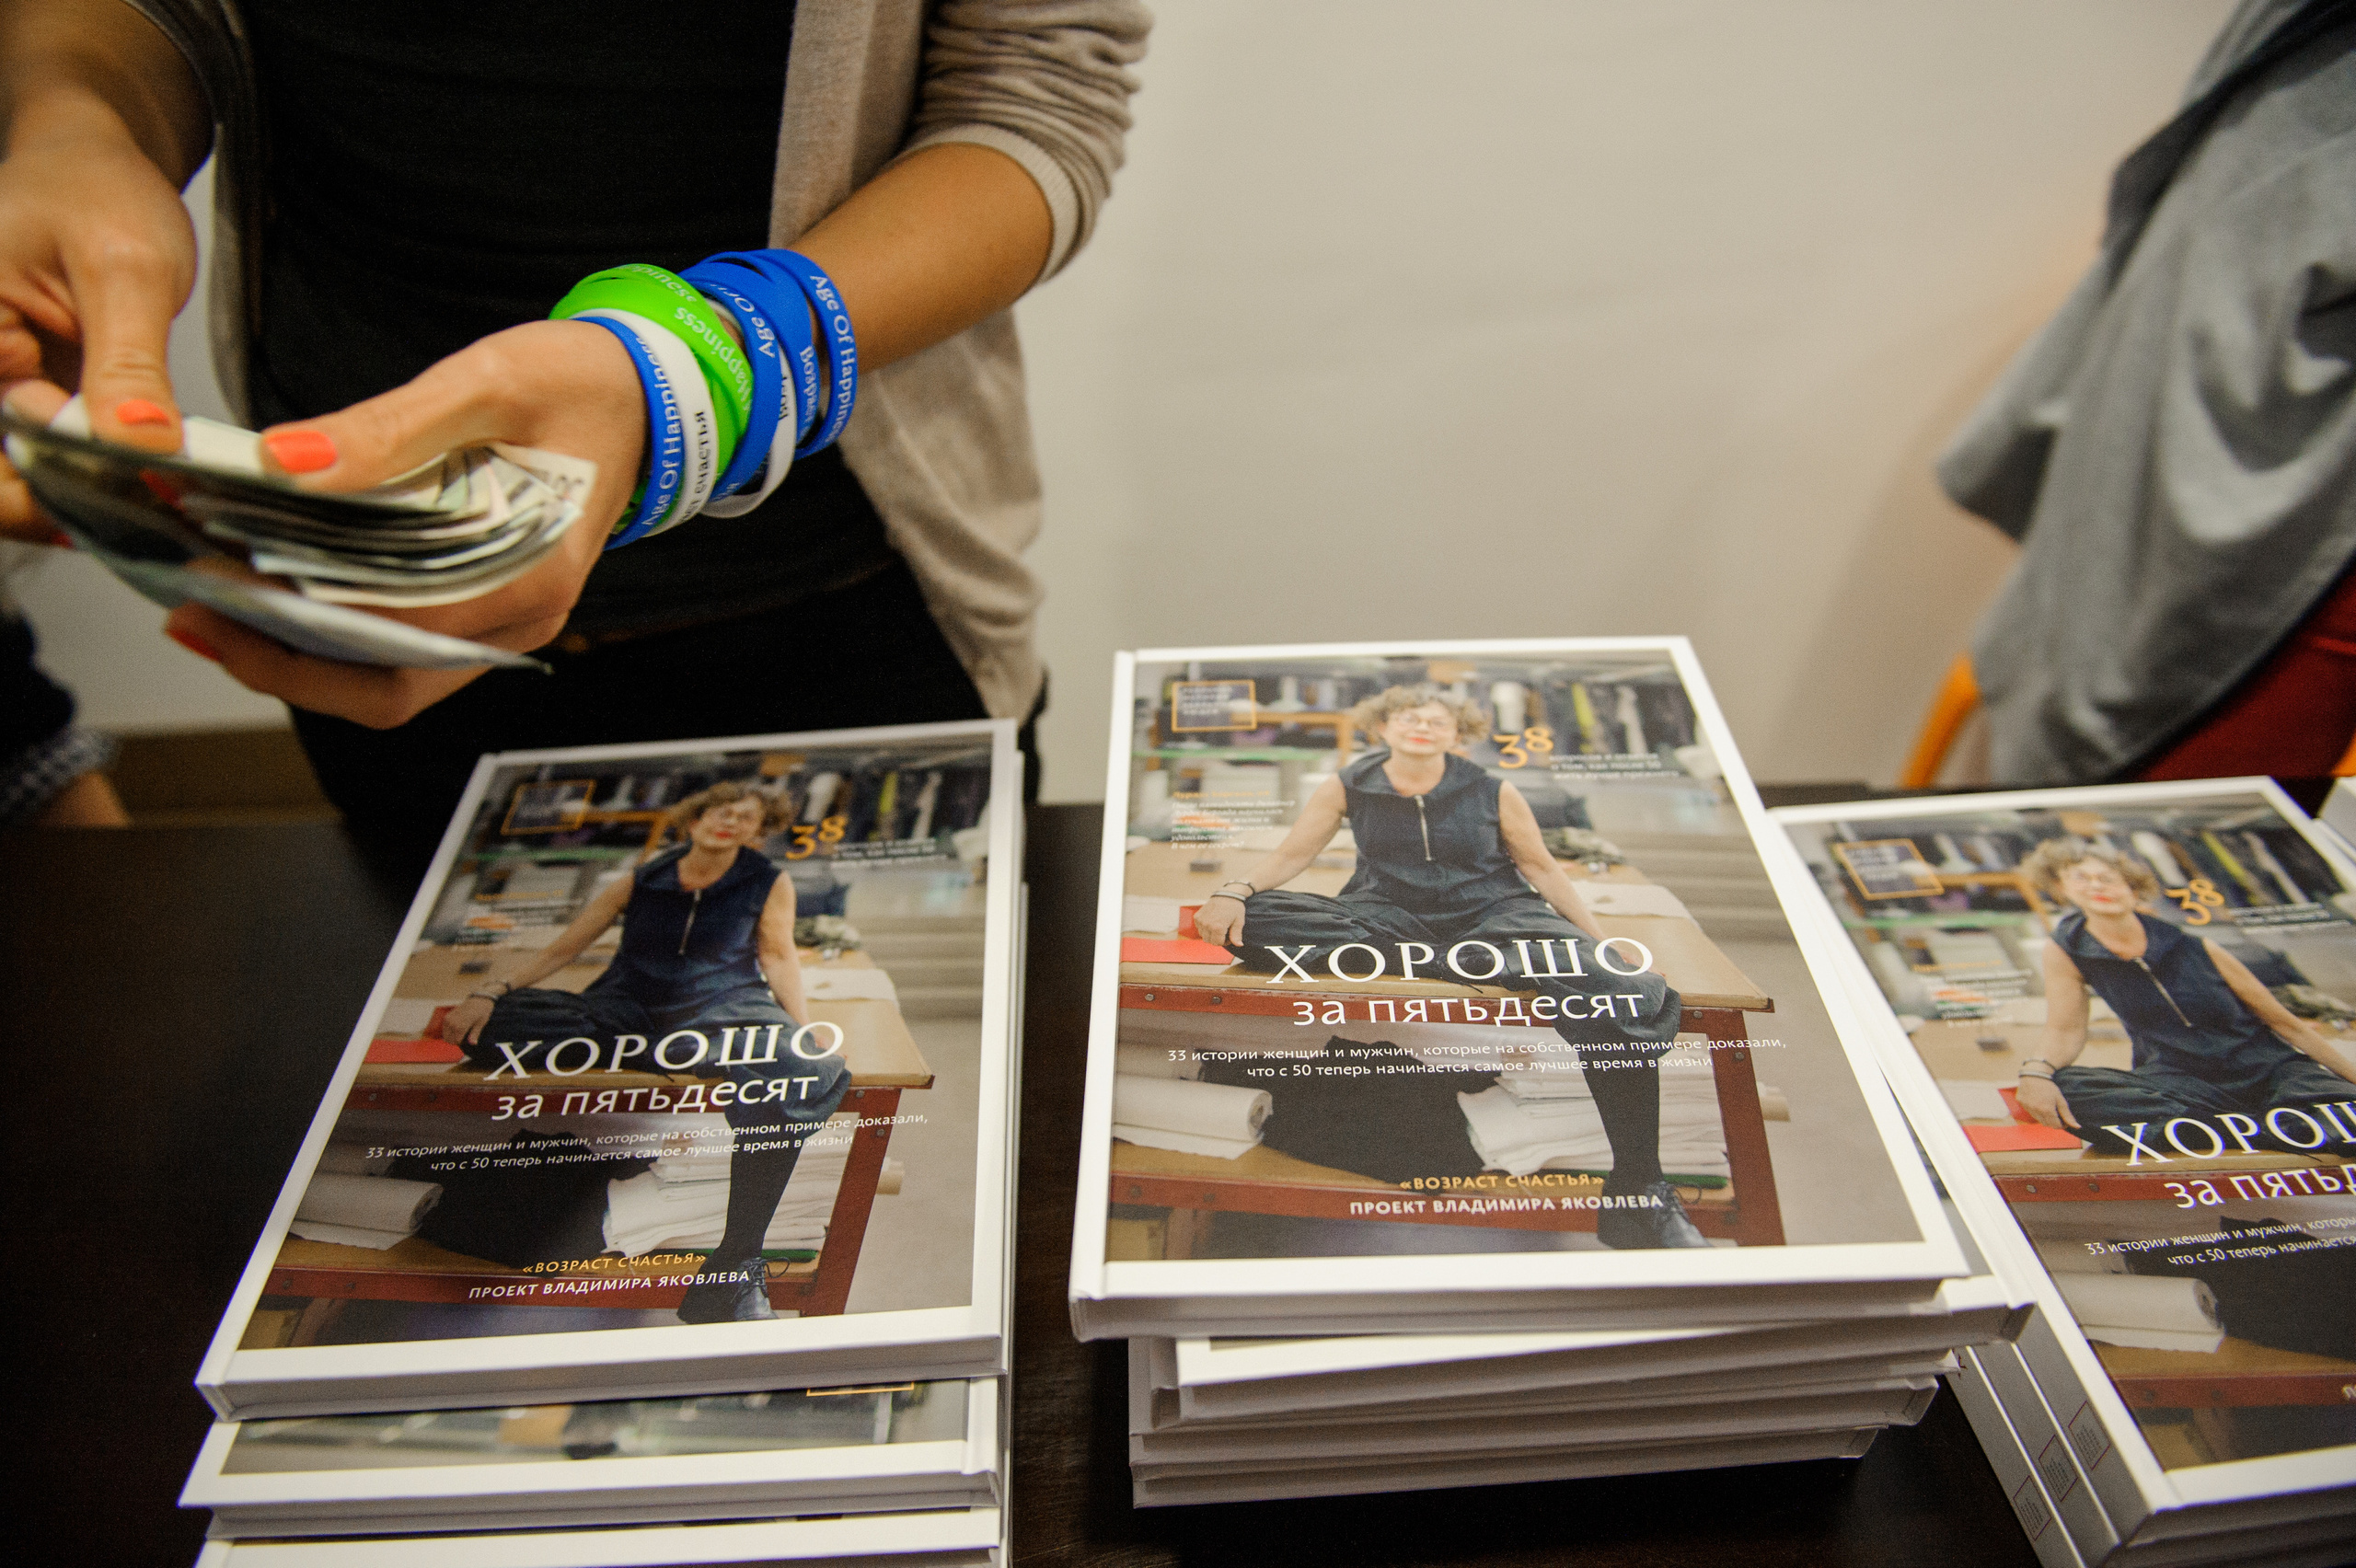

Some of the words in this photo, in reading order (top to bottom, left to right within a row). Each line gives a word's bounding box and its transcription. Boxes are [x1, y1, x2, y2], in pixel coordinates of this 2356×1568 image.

[810, 275, 839, 311] Age
[833, 315, 852, 343] Of
[751, 317, 775, 358] Age
[660, 459, 679, 490] Of
[1493, 726, 1554, 769] 38
[786, 815, 847, 859] 38
[2165, 879, 2224, 926] 38
[1265, 937, 1653, 985] ХОРОШО
[1293, 1000, 1346, 1026] за
[1368, 994, 1646, 1027] пятьдесят
[483, 1020, 845, 1081] ХОРОШО
[1168, 1050, 1186, 1061] 33
[1192, 1049, 1258, 1063] истории
[1263, 1047, 1330, 1061] женщин
[1334, 1048, 1345, 1058] и
[1350, 1046, 1419, 1060] мужчин,
[1423, 1043, 1490, 1058] которые
[1496, 1043, 1516, 1055] на
[1519, 1040, 1626, 1055] собственном
[1630, 1038, 1702, 1053] примере
[1706, 1037, 1786, 1051] доказали,
[1247, 1066, 1276, 1078] что
[1279, 1066, 1288, 1077] с
[1292, 1064, 1311, 1077] 50
[1315, 1065, 1371, 1079] теперь
[1376, 1062, 1470, 1076] начинается
[1473, 1061, 1525, 1072] самое
[1528, 1059, 1588, 1074] лучшее
[1592, 1057, 1643, 1072] время
[1648, 1058, 1657, 1068] в
[1660, 1056, 1713, 1067] жизни
[491, 1094, 544, 1121] за
[560, 1075, 820, 1117] пятьдесят
[365, 1147, 384, 1159] 33
[387, 1146, 448, 1160] истории
[451, 1141, 512, 1155] женщин
[515, 1140, 525, 1150] и
[529, 1136, 592, 1151] мужчин,
[595, 1132, 659, 1147] которые
[662, 1130, 680, 1141] на
[684, 1123, 781, 1140] собственном
[784, 1118, 851, 1134] примере
[854, 1114, 929, 1129] доказали,
[431, 1160, 456, 1171] что
[459, 1160, 468, 1170] с
[471, 1158, 490, 1170] 50
[492, 1156, 542, 1170] теперь
[547, 1150, 631, 1165] начинается
[635, 1147, 682, 1159] самое
[684, 1143, 740, 1157] лучшее
[743, 1139, 790, 1154] время
[793, 1138, 803, 1148] в
[805, 1135, 854, 1147] жизни
[1399, 1176, 1499, 1191] «ВОЗРАСТ
[1506, 1173, 1606, 1188] СЧАСТЬЯ»
[2164, 1179, 2224, 1209] за
[1349, 1200, 1426, 1216] ПРОЕКТ
[1433, 1197, 1555, 1215] ВЛАДИМИРА
[1561, 1194, 1664, 1210] ЯКОВЛЕВА
[2085, 1242, 2107, 1256] 33
[2108, 1238, 2169, 1253] истории
[2170, 1230, 2232, 1246] женщин
[2232, 1228, 2243, 1239] и
[2246, 1222, 2307, 1239] мужчин,
[2167, 1253, 2194, 1266] что
[2197, 1252, 2206, 1263] с
[2205, 1249, 2227, 1262] 50
[2227, 1245, 2278, 1261] теперь
[522, 1256, 610, 1274] «ВОЗРАСТ
[618, 1252, 707, 1268] СЧАСТЬЯ»
[468, 1284, 538, 1299] ПРОЕКТ
[543, 1276, 653, 1296] ВЛАДИМИРА
[657, 1270, 750, 1288] ЯКОВЛЕВА
